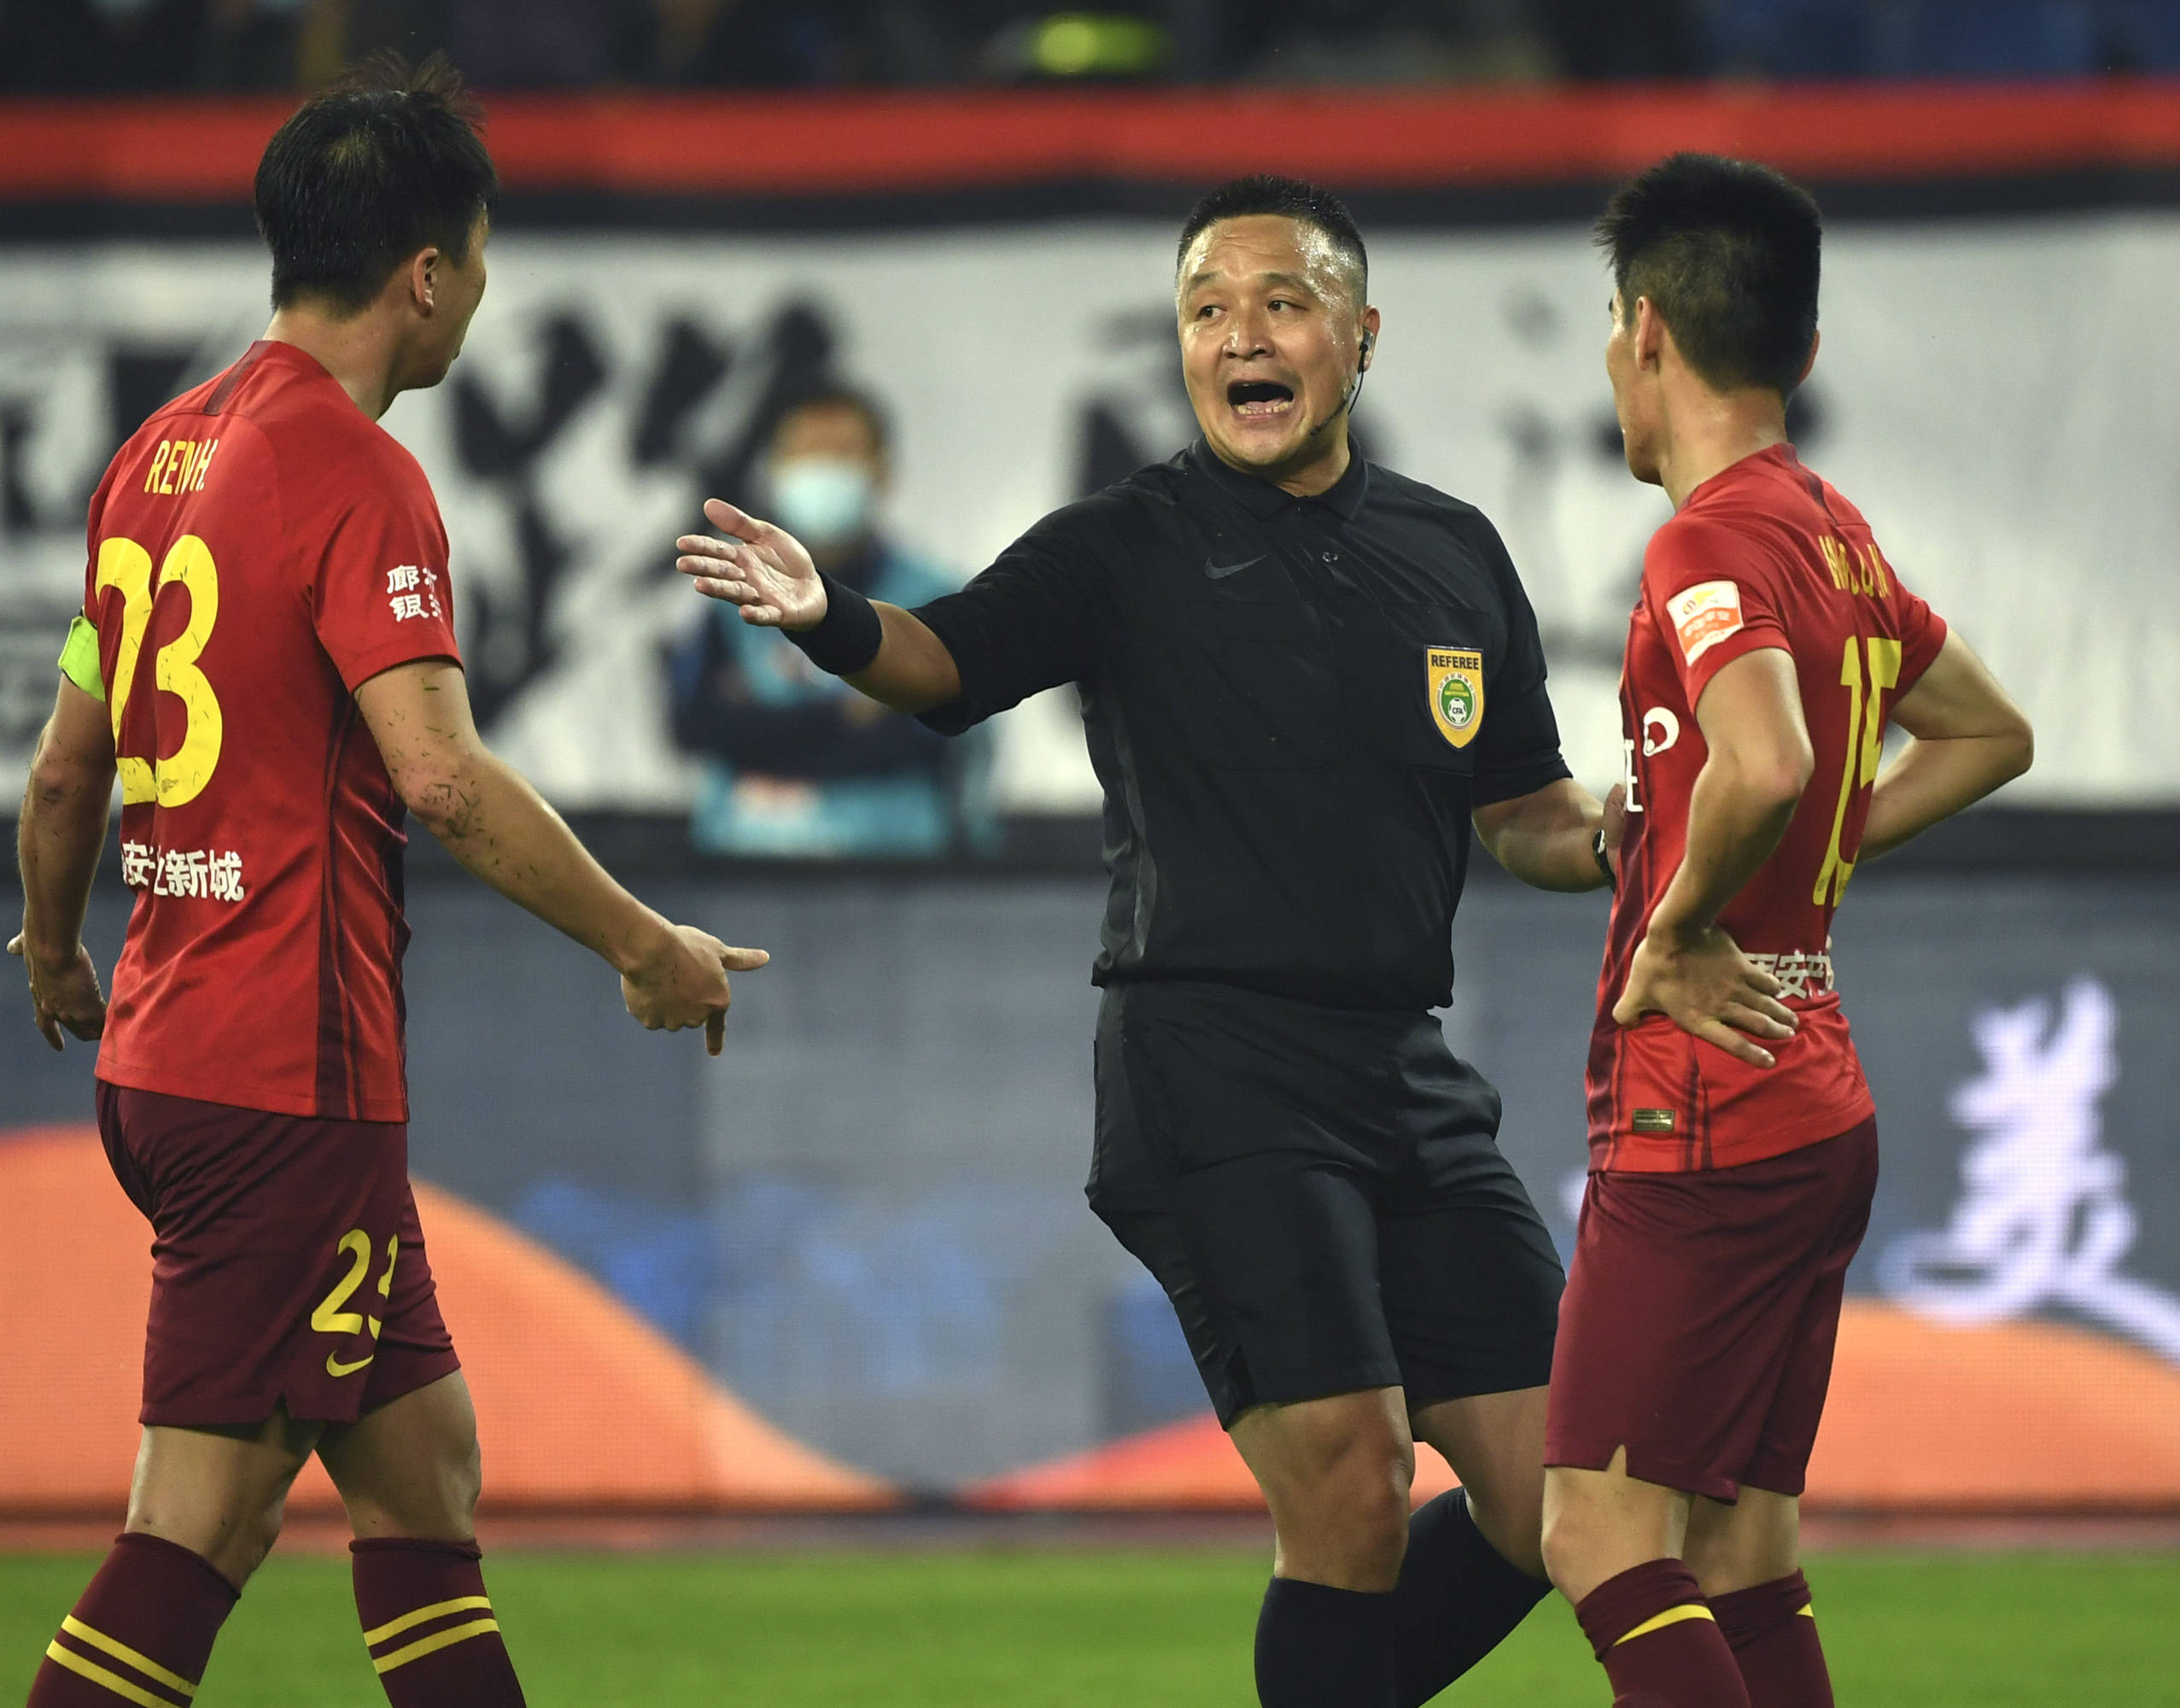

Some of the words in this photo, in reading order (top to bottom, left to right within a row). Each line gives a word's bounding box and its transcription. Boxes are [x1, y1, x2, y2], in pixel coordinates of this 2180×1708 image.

[95, 534, 223, 808] 23
[1431, 654, 1479, 670] REFEREE
[1813, 635, 1902, 909] 15
